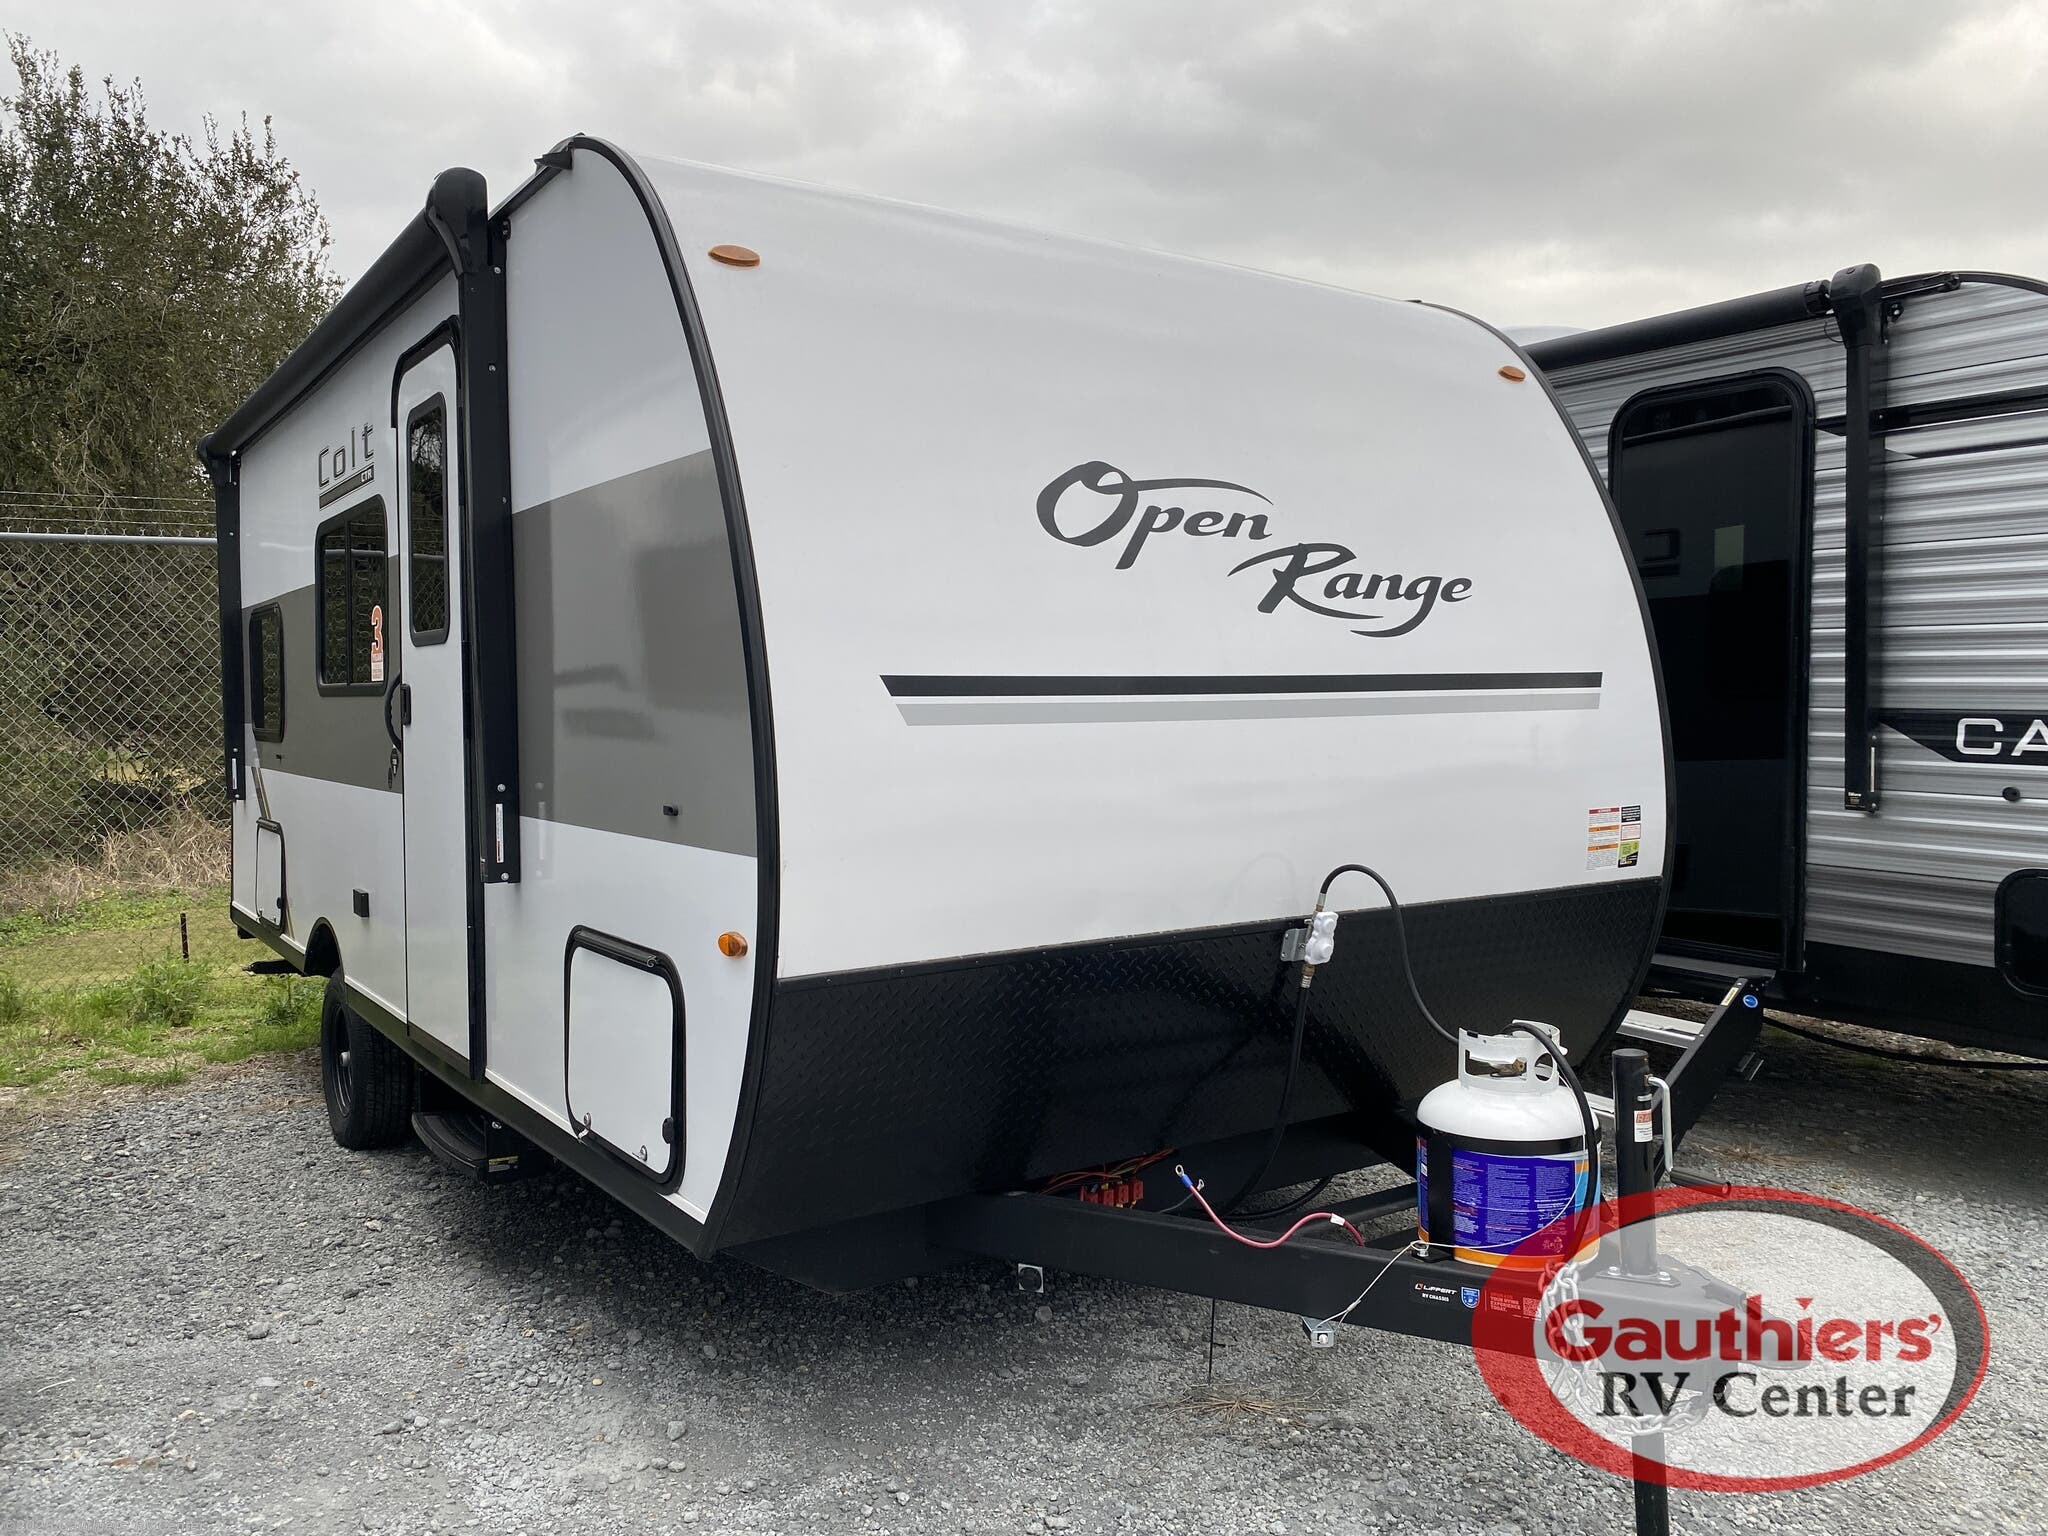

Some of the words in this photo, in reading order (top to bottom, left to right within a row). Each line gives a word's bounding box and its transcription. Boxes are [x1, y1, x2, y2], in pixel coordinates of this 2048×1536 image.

[319, 424, 374, 487] Colt
[1036, 460, 1274, 570] Open
[371, 605, 383, 653] 3
[1227, 543, 1473, 638] Range
